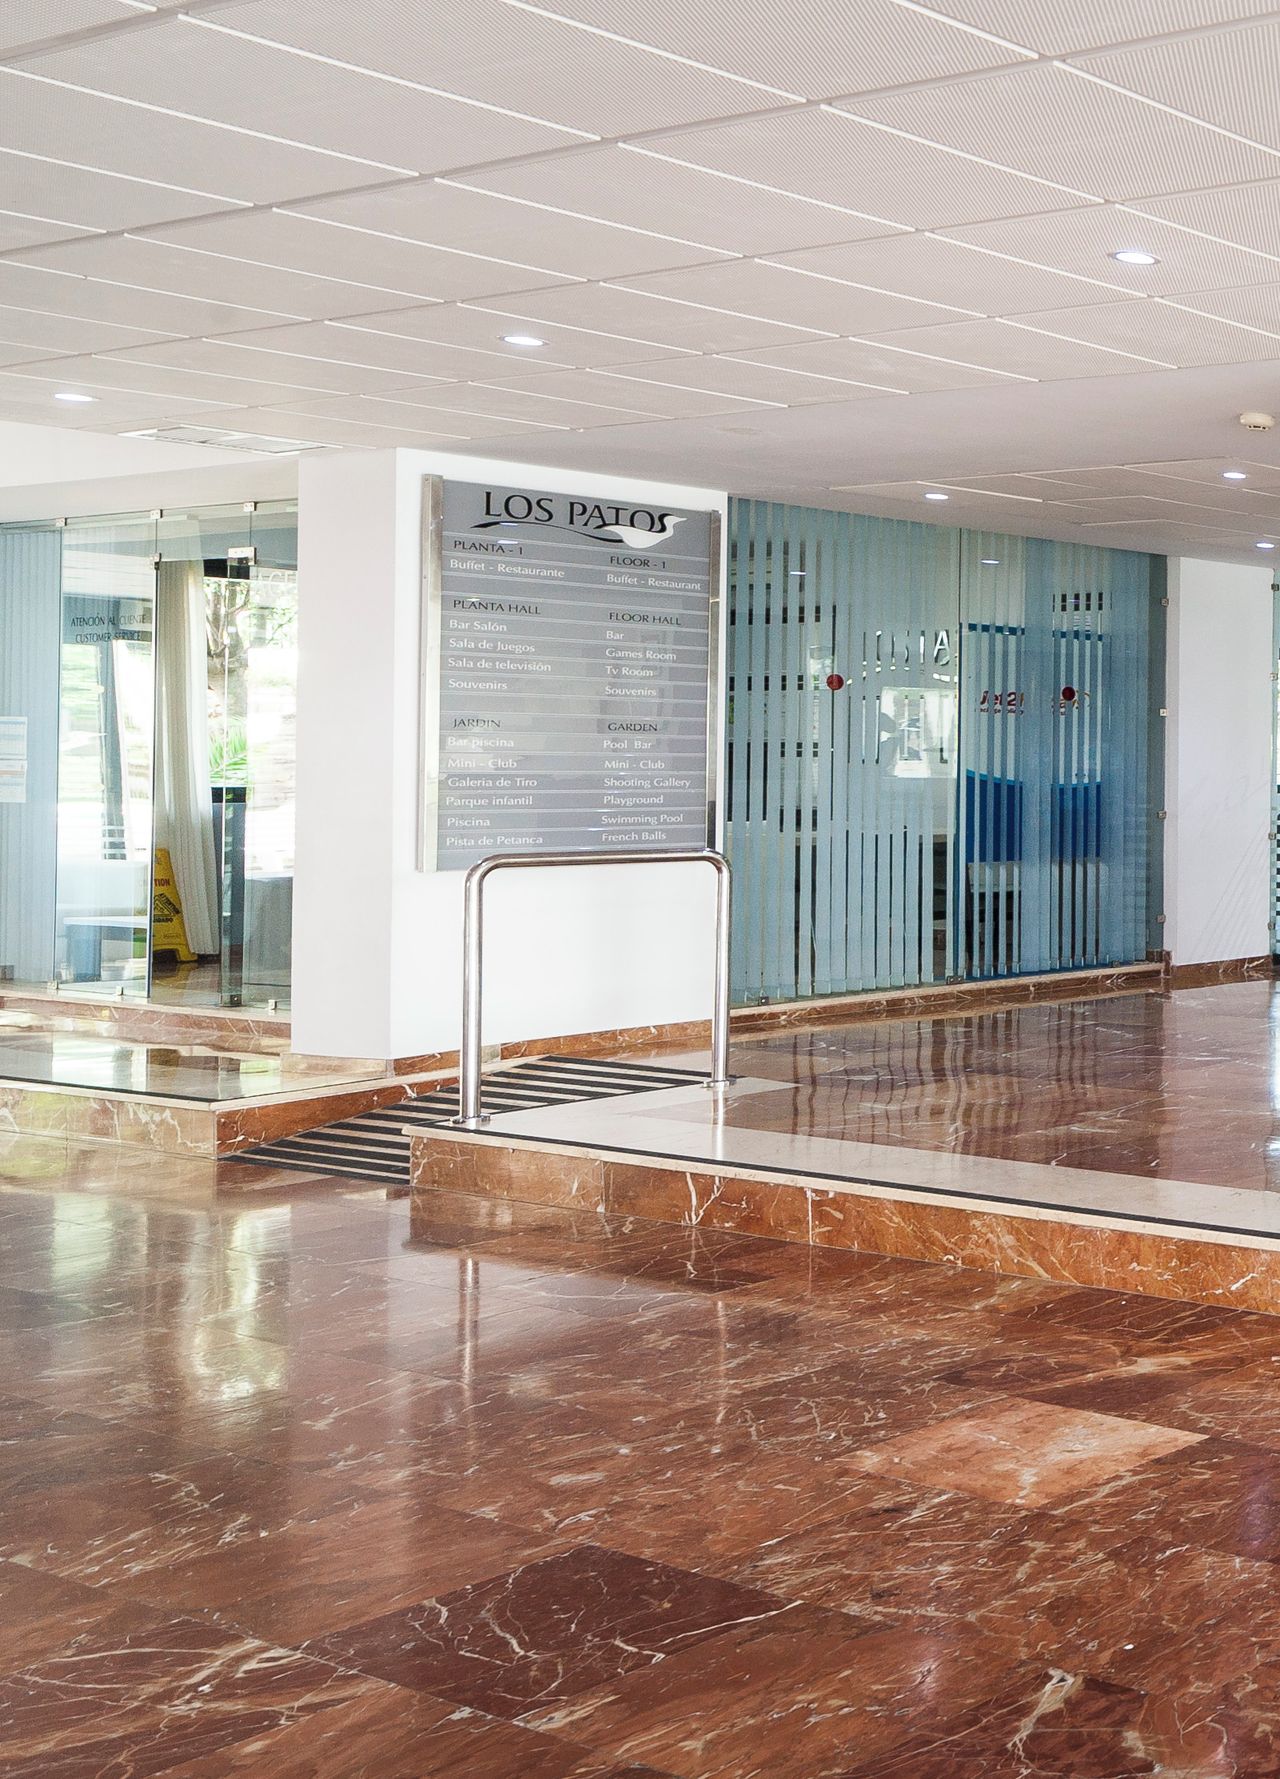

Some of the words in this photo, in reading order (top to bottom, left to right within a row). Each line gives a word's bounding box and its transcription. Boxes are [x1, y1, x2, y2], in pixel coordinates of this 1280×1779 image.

[484, 491, 554, 522] LOS
[568, 501, 674, 533] PATOS
[453, 540, 505, 554] PLANTA
[610, 555, 650, 568] FLOOR
[450, 559, 486, 571] Buffet
[498, 563, 565, 578] Restaurante
[606, 574, 638, 586] Buffet
[648, 577, 701, 590] Restaurant
[453, 599, 505, 612] PLANTA
[509, 603, 541, 615] HALL
[71, 612, 105, 627] ATENCIÓN
[108, 615, 116, 626] AL
[120, 614, 147, 626] CLIENTE
[609, 612, 648, 624] FLOOR
[652, 614, 681, 626] HALL
[449, 619, 470, 630] Bar
[473, 620, 507, 632] Salón
[75, 632, 112, 643] CUSTOMER
[114, 631, 142, 641] SERVICE
[606, 630, 624, 640] Bar
[449, 638, 474, 649] Sala
[478, 639, 493, 650] de
[496, 641, 536, 654] Juegos
[606, 648, 642, 659] Games
[646, 649, 676, 661] Room
[448, 657, 473, 668] Sala
[477, 658, 492, 669] de
[496, 659, 551, 672] televisión
[605, 665, 619, 676] Tv
[622, 666, 653, 677] Room
[448, 679, 508, 690] Souvenirs
[605, 686, 657, 697] Souvenirs
[453, 718, 501, 729] JARDIN
[608, 722, 658, 732] GARDEN
[603, 739, 628, 750] Pool
[634, 740, 652, 749] Bar
[447, 758, 475, 769] Mini
[488, 758, 517, 769] Club
[605, 759, 630, 769] Mini
[641, 759, 665, 769] Club
[448, 777, 493, 788] Galeria
[496, 777, 511, 788] de
[515, 777, 537, 787] Tiro
[603, 777, 650, 788] Shooting
[653, 777, 691, 788] Gallery
[446, 796, 488, 809] Parque
[492, 795, 533, 806] infantil
[603, 794, 663, 807] Playground
[447, 816, 490, 827] Piscina
[601, 814, 657, 826] Swimming
[660, 813, 683, 823] Pool
[446, 836, 474, 847] Pista
[478, 836, 494, 846] de
[498, 835, 543, 846] Petanca
[602, 832, 638, 842] French
[641, 831, 666, 841] Balls
